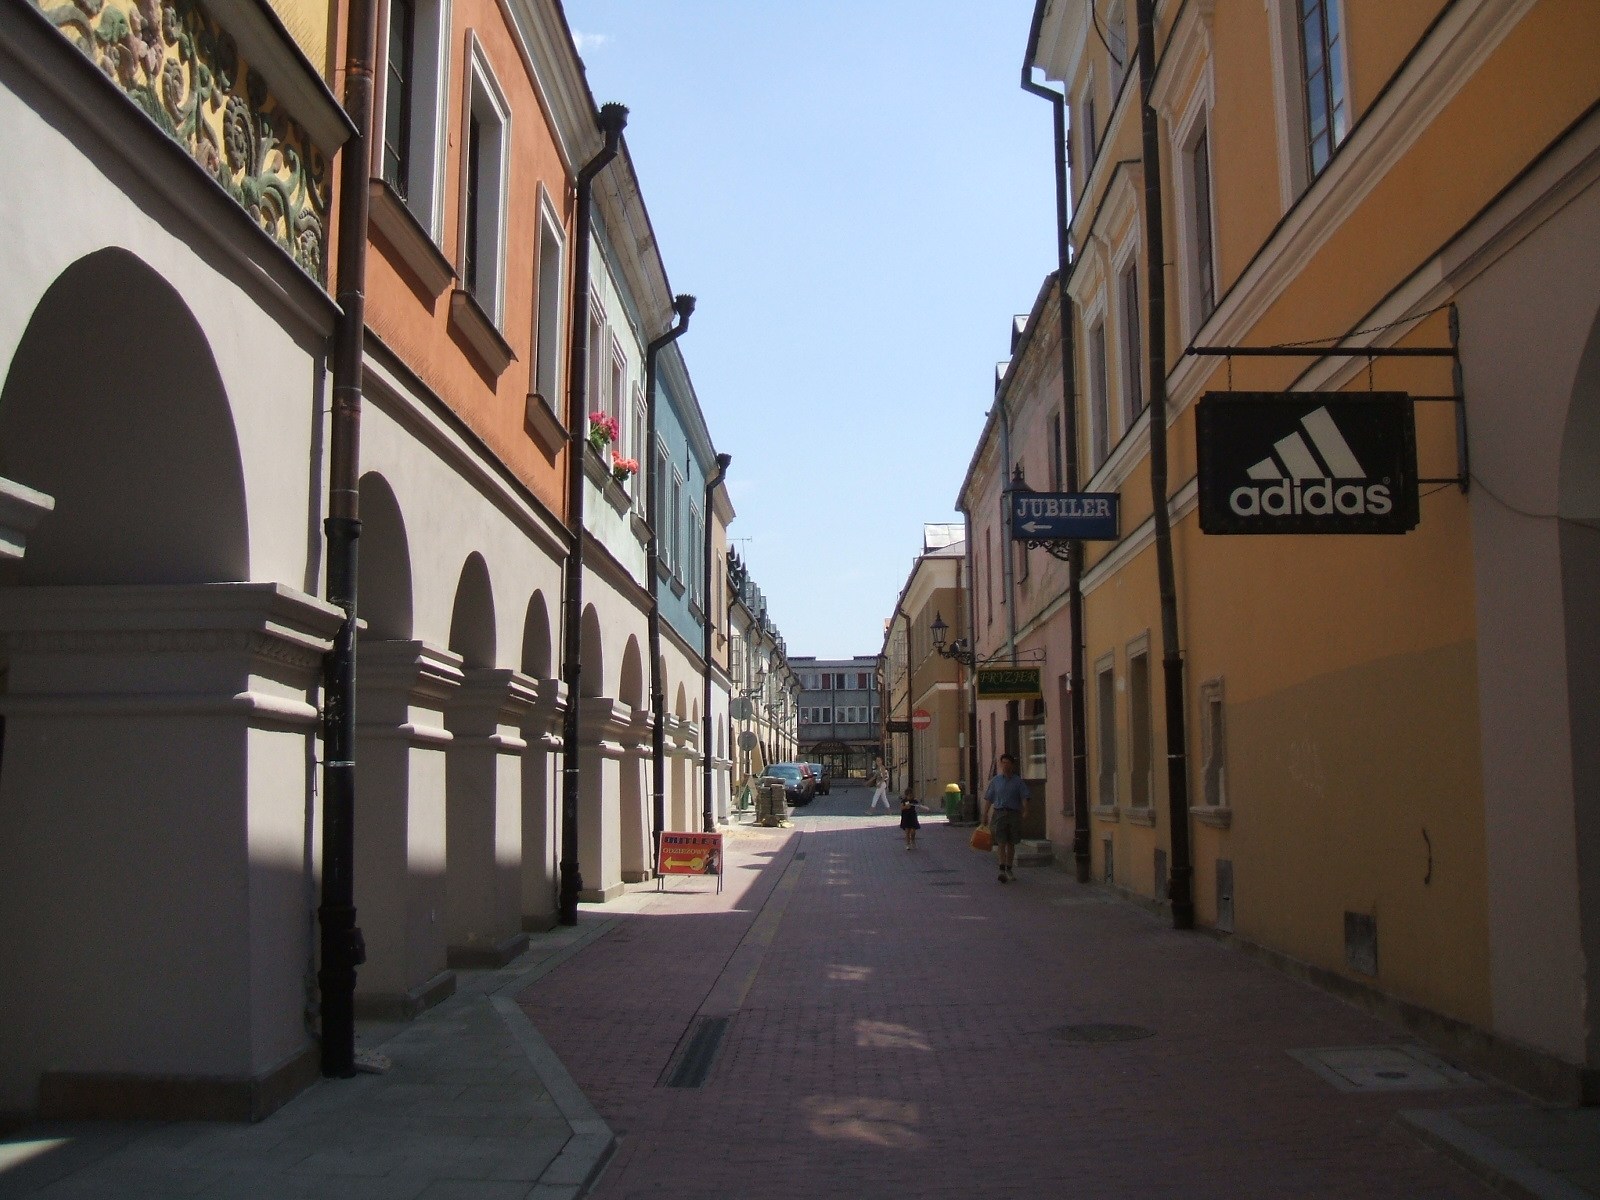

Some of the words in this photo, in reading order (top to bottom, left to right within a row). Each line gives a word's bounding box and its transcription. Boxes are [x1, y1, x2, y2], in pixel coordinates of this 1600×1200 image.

[1229, 478, 1392, 516] adidas
[1017, 498, 1111, 517] JUBILER
[980, 671, 1039, 684] FRYZJER
